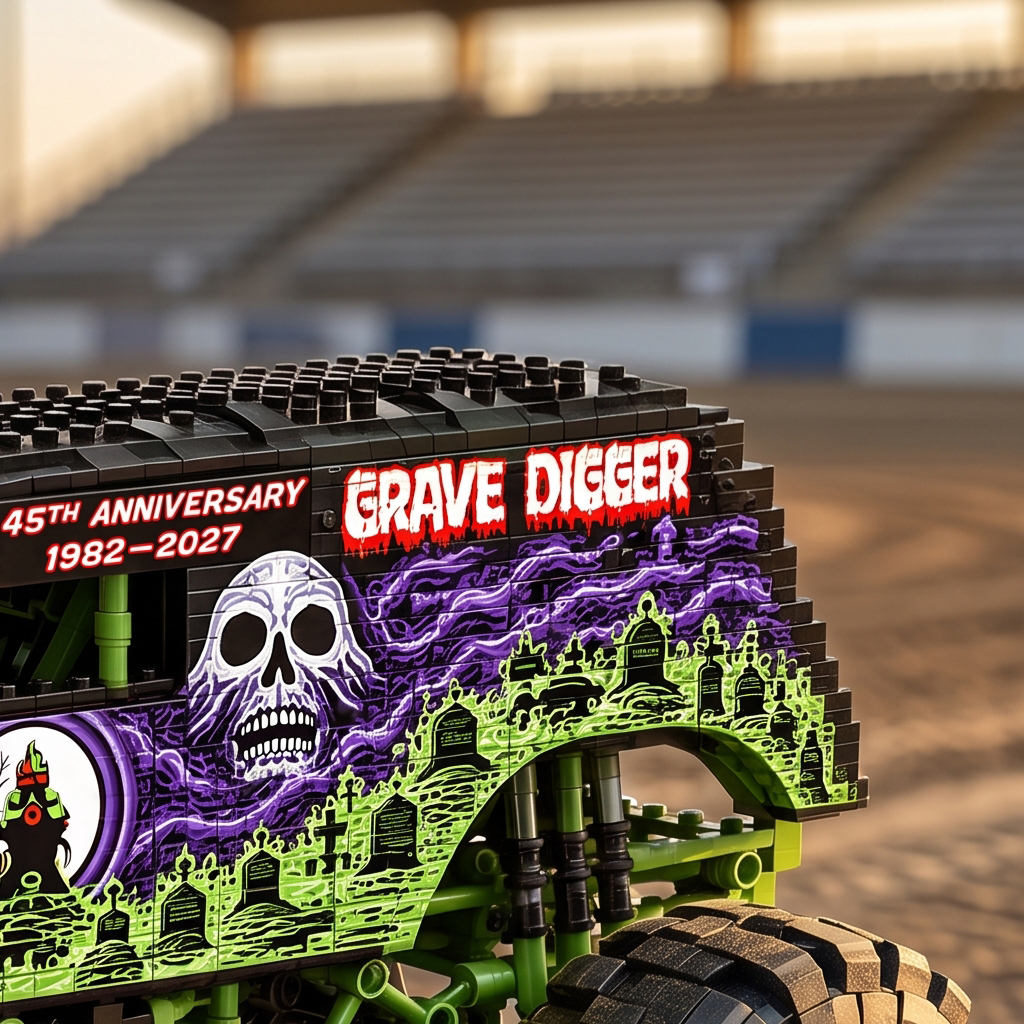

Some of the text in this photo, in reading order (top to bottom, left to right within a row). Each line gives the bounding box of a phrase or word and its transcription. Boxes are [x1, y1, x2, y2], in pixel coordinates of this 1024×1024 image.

[1, 476, 309, 537] 45TH ANNIVERSARY
[343, 435, 692, 548] GRAVE DIGGER
